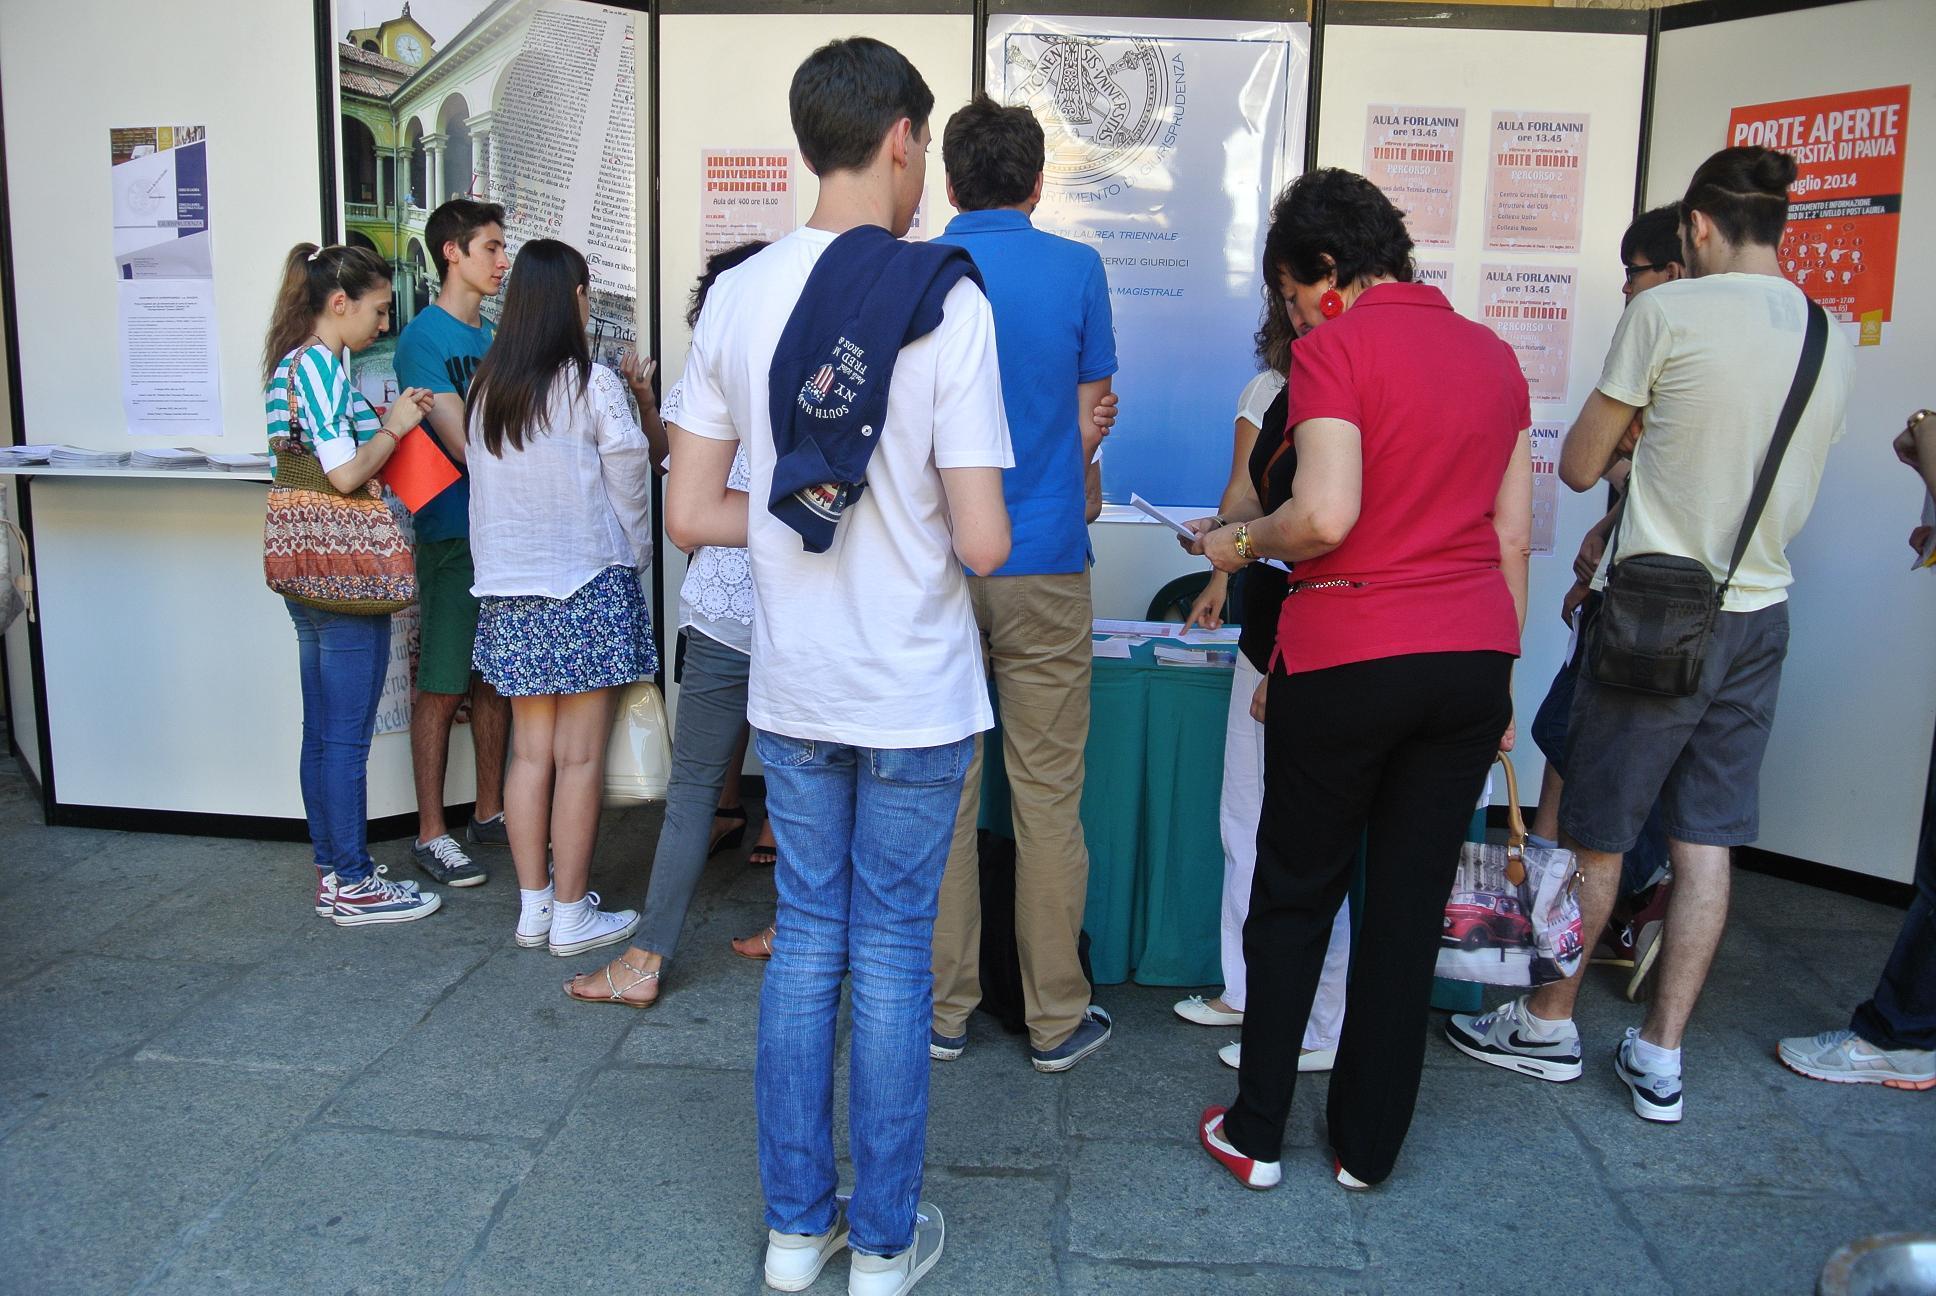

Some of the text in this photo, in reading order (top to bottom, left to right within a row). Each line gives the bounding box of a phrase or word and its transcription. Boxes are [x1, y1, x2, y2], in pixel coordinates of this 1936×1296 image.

[1140, 52, 1187, 176] GIURISPRUDENZA
[1373, 115, 1459, 128] AULA FORLANINI
[1497, 121, 1584, 133] AULA FORLANINI
[1734, 104, 1901, 149] PORTE APERTE
[1412, 128, 1438, 138] 13.45
[1536, 134, 1562, 143] 13.45
[1838, 141, 1853, 161] DI
[1854, 137, 1898, 159] PAVIA
[1787, 172, 1857, 195] uglio 2014
[1788, 202, 1824, 213] IENTAMENTO
[1846, 206, 1860, 217] POST
[1073, 229, 1116, 240] LAUREA
[1119, 231, 1179, 241] TRIENNALE
[1139, 257, 1189, 267] GIURIDICI
[1414, 269, 1447, 280] LANINI
[1486, 271, 1571, 284] AULA FORLANINI
[1116, 287, 1184, 297] MAGISTRALE
[1524, 284, 1551, 294] 13.45
[841, 352, 868, 376] FRED
[834, 382, 857, 403] NY
[815, 404, 849, 419] SOUTH
